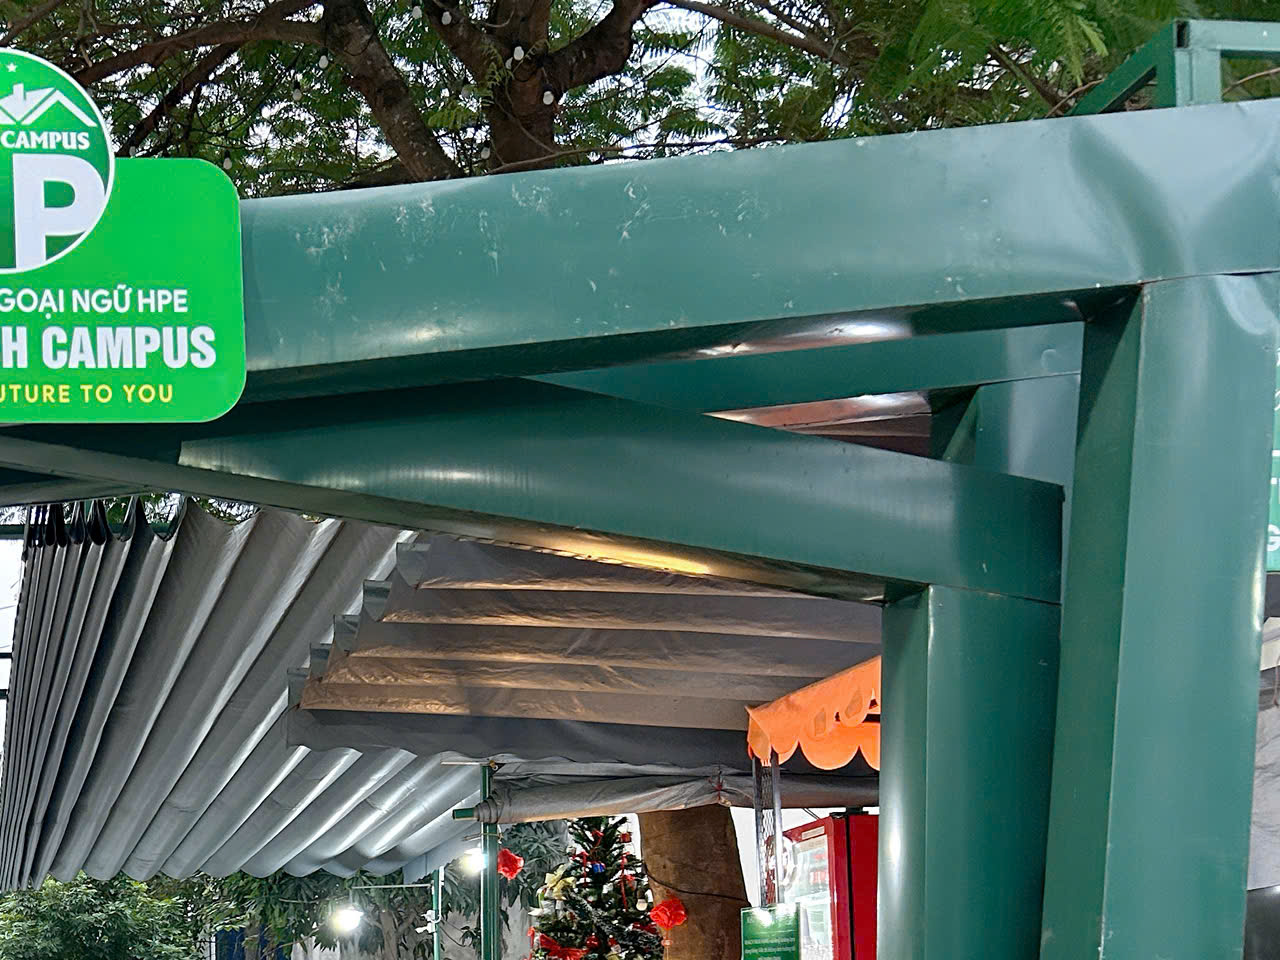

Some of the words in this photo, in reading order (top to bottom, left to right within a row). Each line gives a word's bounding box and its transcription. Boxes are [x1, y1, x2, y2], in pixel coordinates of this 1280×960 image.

[0, 130, 90, 150] CAMPUS
[72, 284, 132, 313] NGỮ
[138, 289, 188, 313] HPE
[42, 326, 217, 369] CAMPUS
[80, 384, 113, 403] TO
[123, 384, 174, 403] YOU
